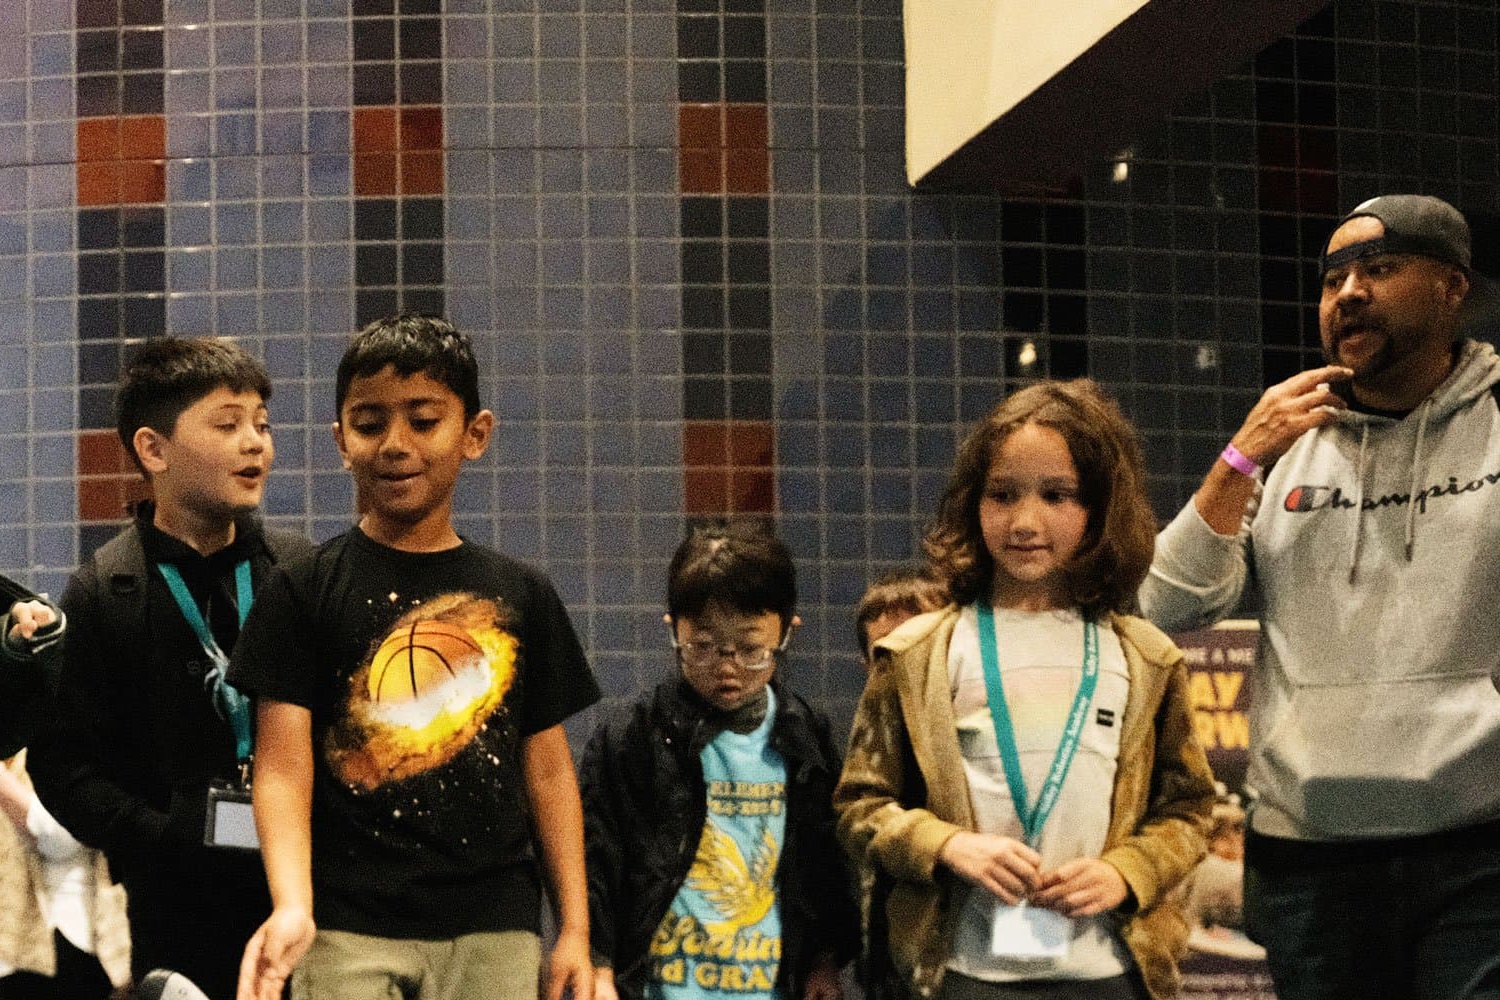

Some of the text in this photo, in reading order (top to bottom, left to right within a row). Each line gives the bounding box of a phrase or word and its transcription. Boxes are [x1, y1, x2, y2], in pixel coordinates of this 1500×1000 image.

[1189, 671, 1244, 708] AY
[650, 910, 783, 961] Soarin
[693, 961, 780, 990] GRA
